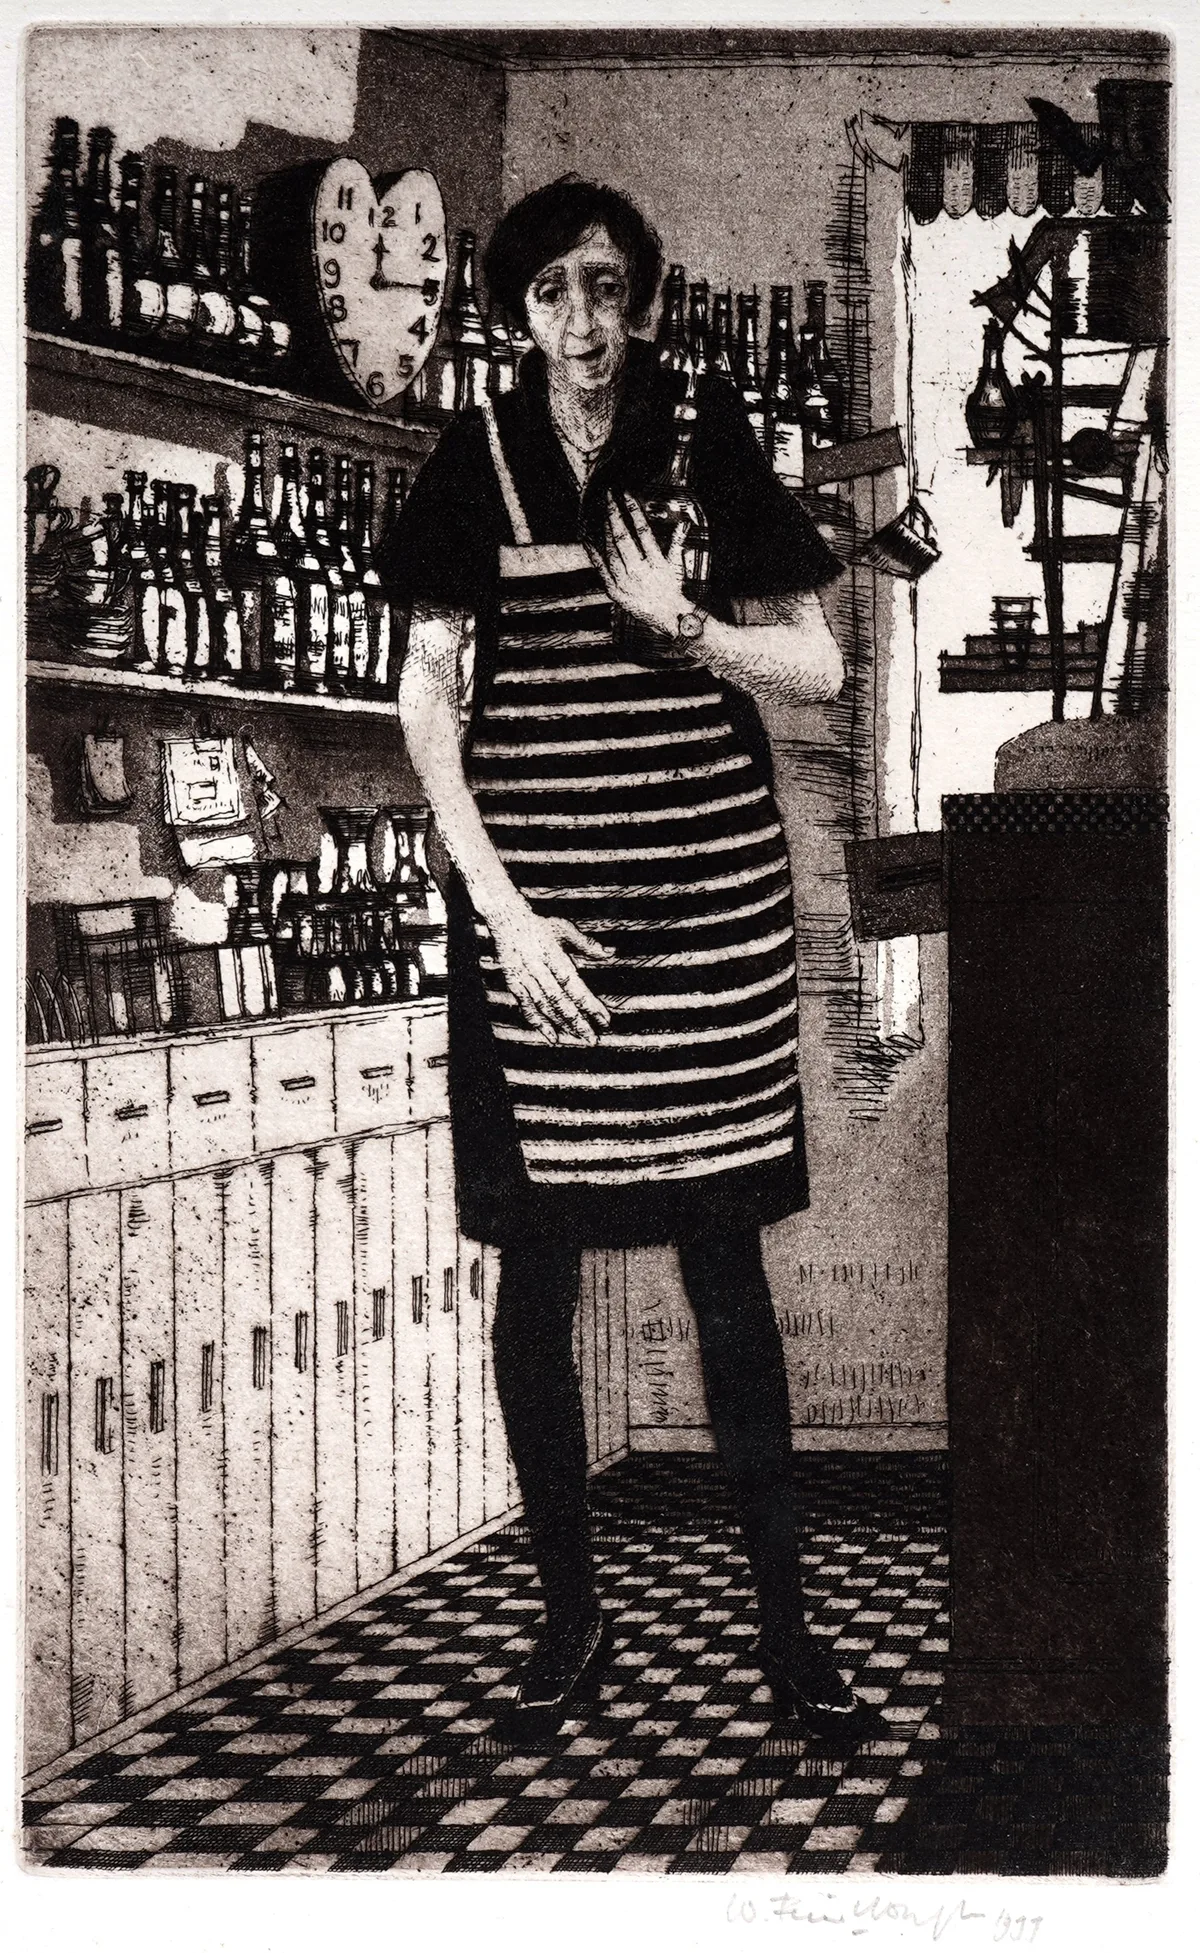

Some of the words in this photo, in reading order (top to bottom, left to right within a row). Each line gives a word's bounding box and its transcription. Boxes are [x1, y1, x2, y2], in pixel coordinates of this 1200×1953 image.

[337, 184, 353, 211] 11
[368, 206, 398, 228] 12
[415, 202, 422, 225] 1
[322, 219, 346, 244] 10
[421, 233, 441, 262] 2
[323, 258, 341, 288] 9
[329, 294, 347, 323] 8
[408, 315, 430, 345] 4
[338, 338, 361, 368] 7
[397, 354, 414, 378] 5
[366, 371, 385, 398] 6
